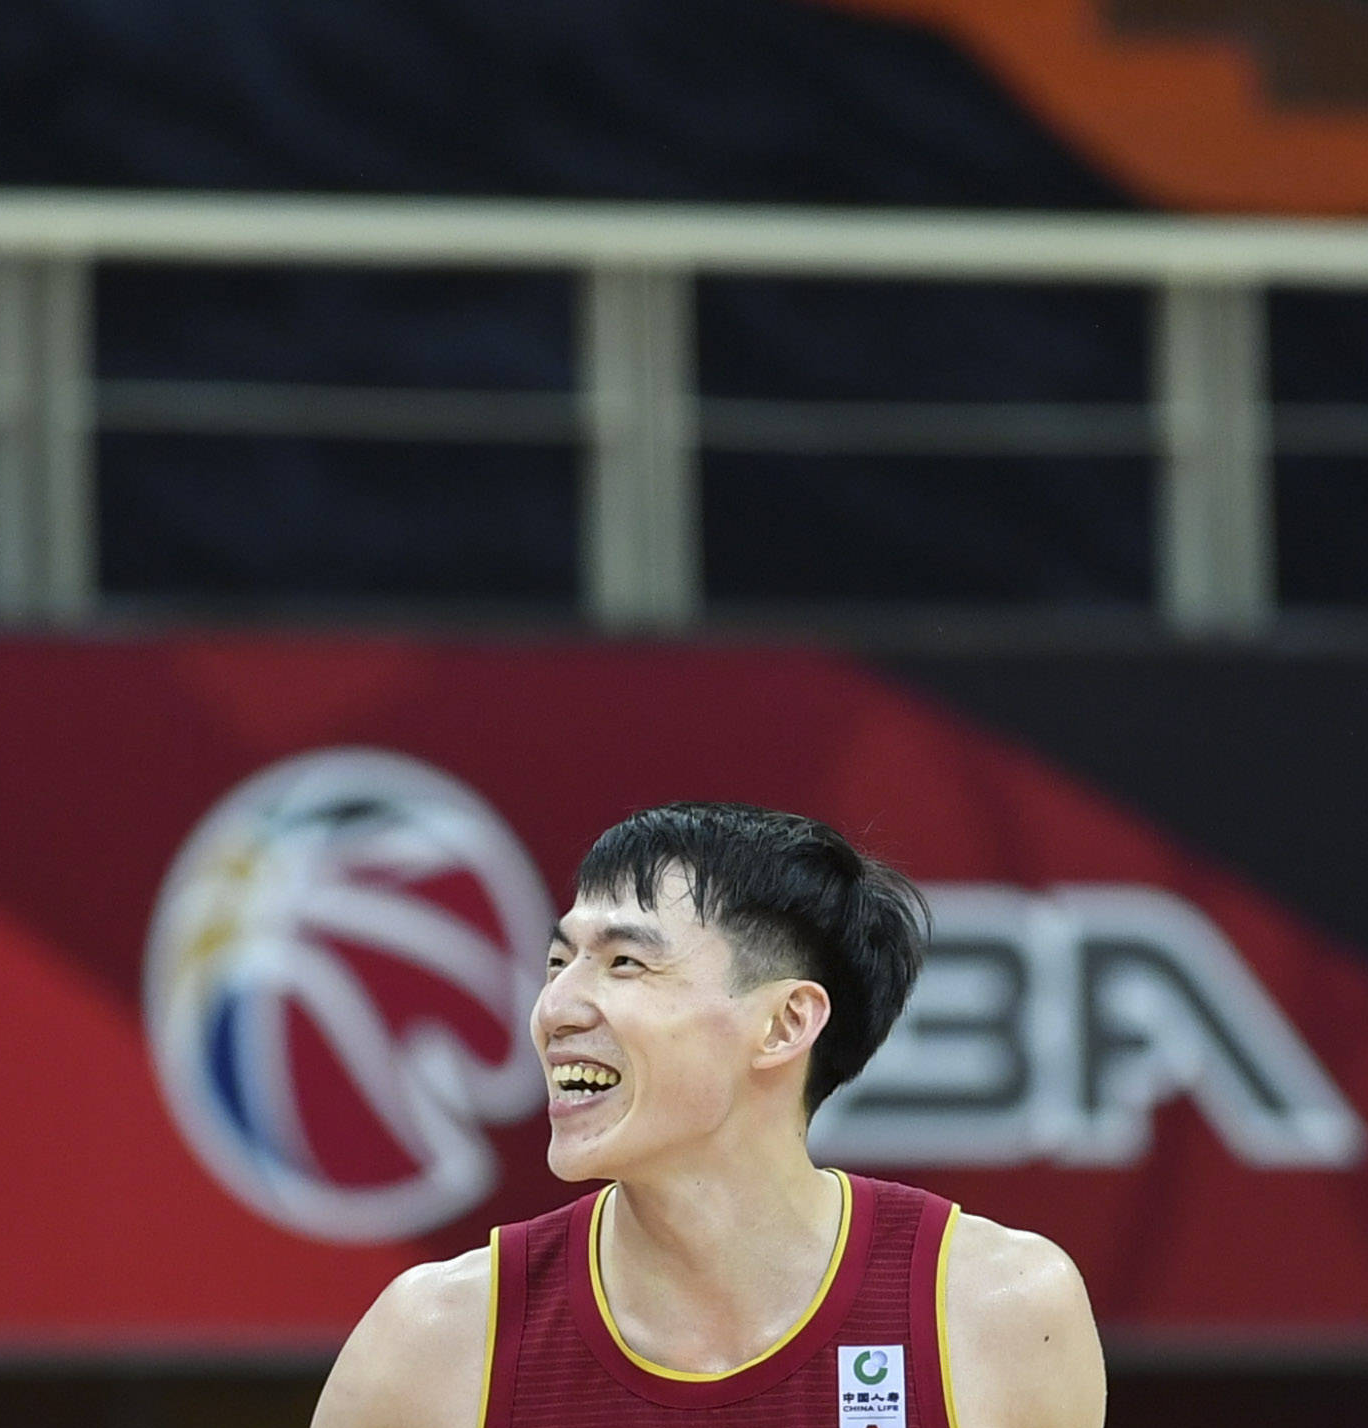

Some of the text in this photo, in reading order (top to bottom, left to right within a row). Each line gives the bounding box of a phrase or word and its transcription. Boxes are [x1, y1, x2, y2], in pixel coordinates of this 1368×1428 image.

[843, 1392, 900, 1403] 中国人寿
[877, 1404, 900, 1412] LIFE
